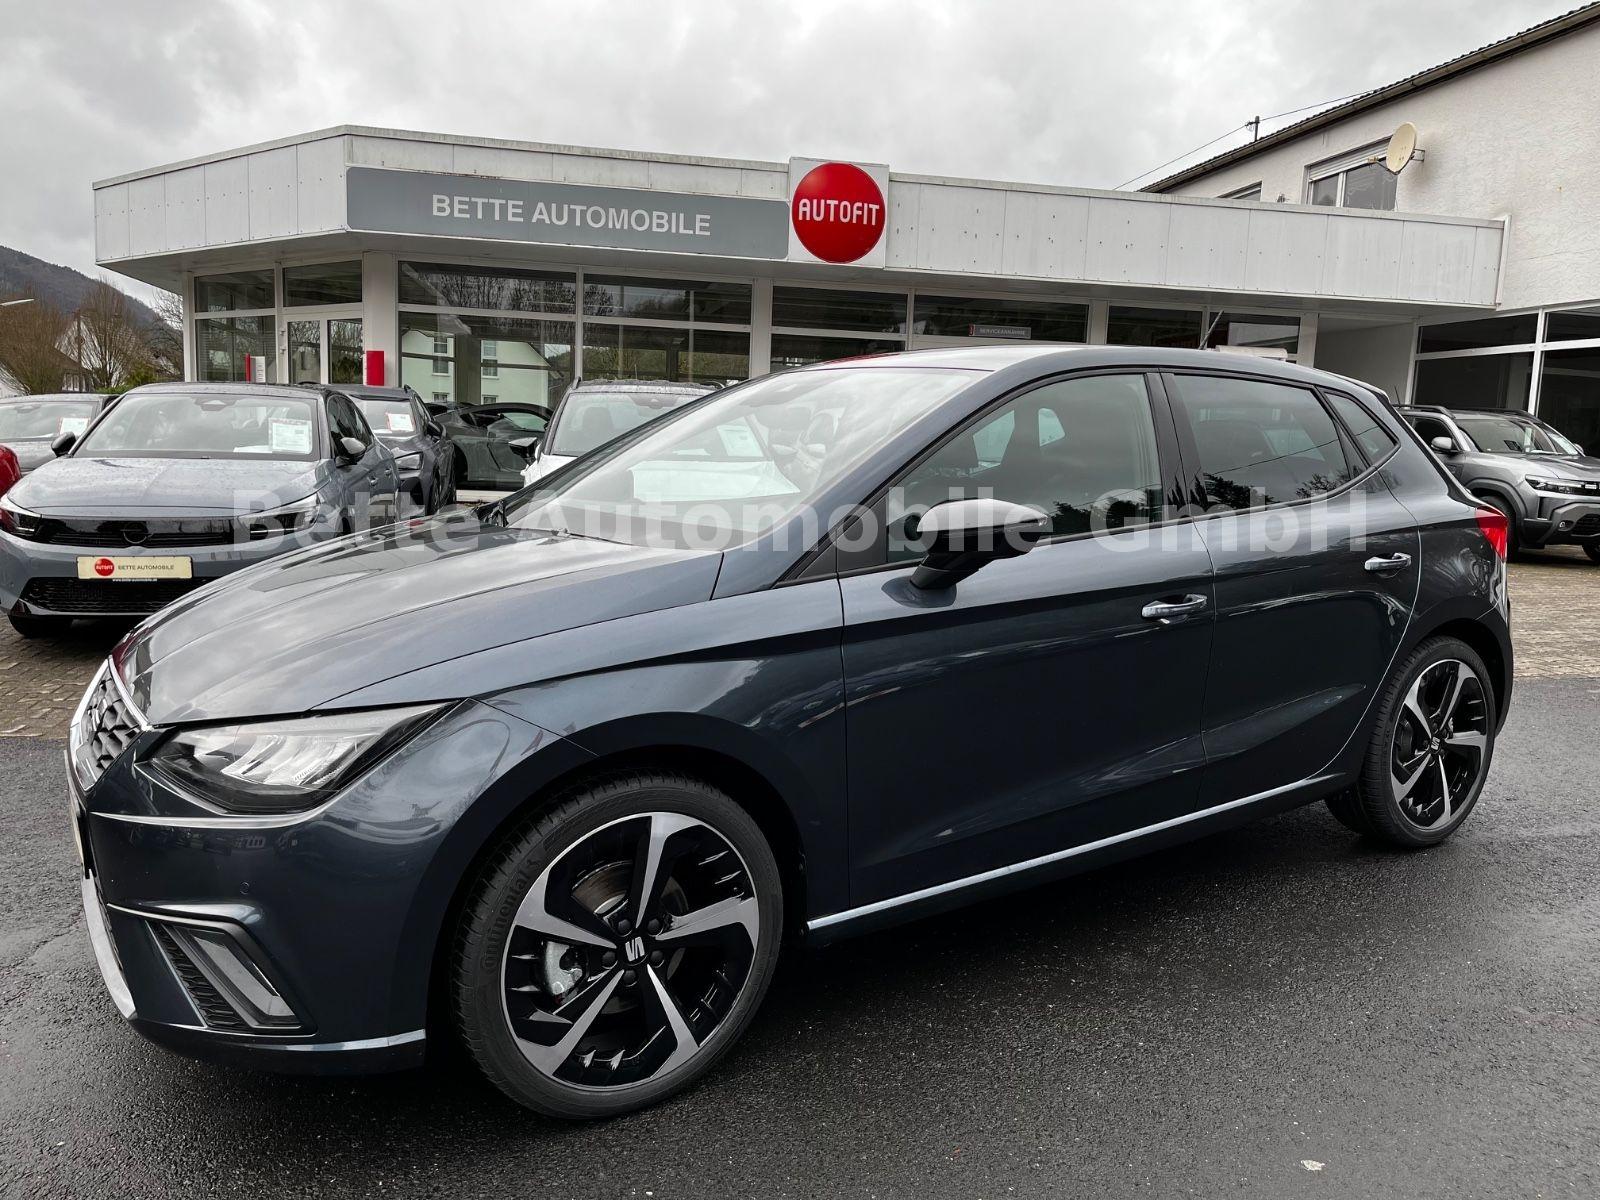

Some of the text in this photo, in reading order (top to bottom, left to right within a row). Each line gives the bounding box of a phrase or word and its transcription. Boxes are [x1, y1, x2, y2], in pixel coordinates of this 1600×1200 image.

[432, 194, 712, 236] BETTE AUTOMOBILE
[798, 198, 880, 226] AUTOFIT
